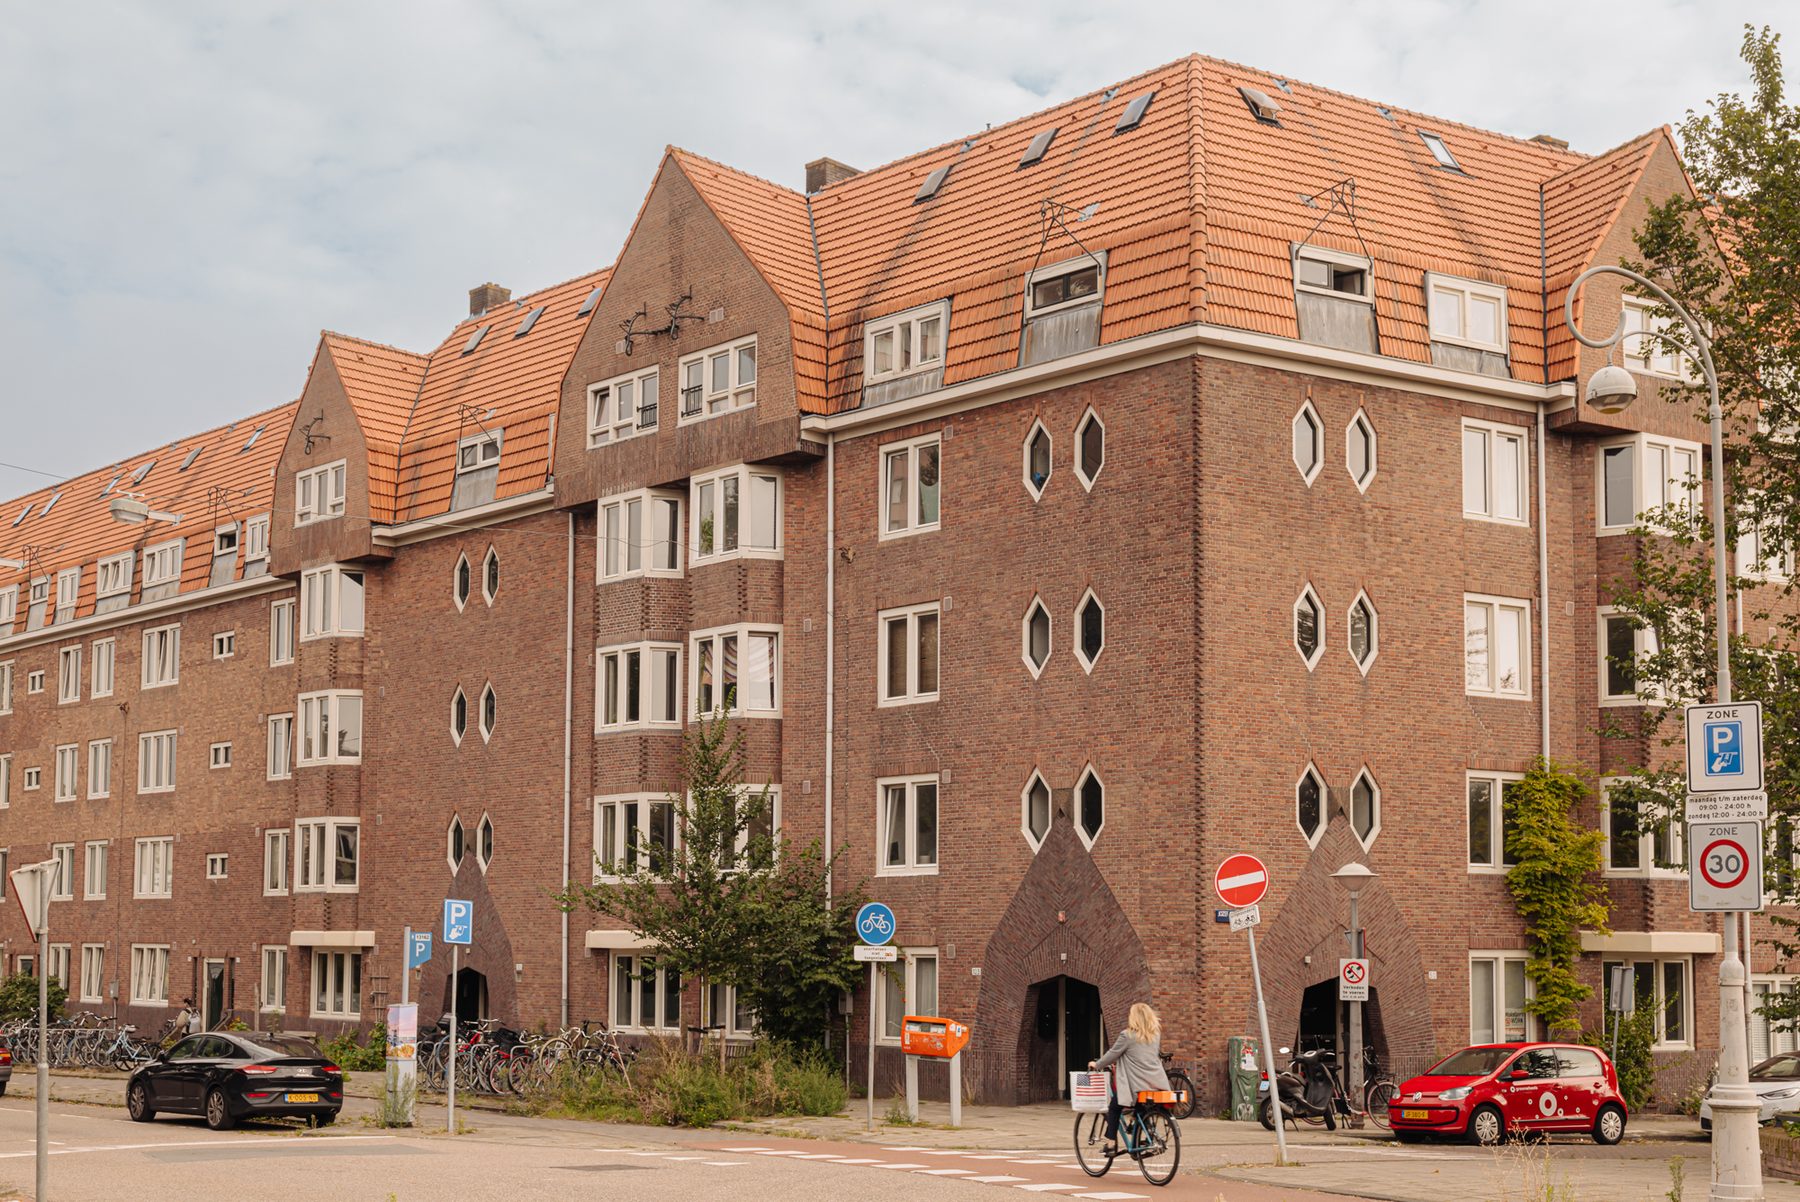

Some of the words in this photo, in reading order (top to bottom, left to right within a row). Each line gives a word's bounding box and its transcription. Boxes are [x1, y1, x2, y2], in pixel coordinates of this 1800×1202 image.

[1707, 710, 1738, 719] ZONE
[1712, 727, 1733, 754] P
[1709, 827, 1738, 836] ZONE
[1709, 854, 1740, 874] 30
[450, 903, 466, 925] P
[416, 942, 425, 957] P
